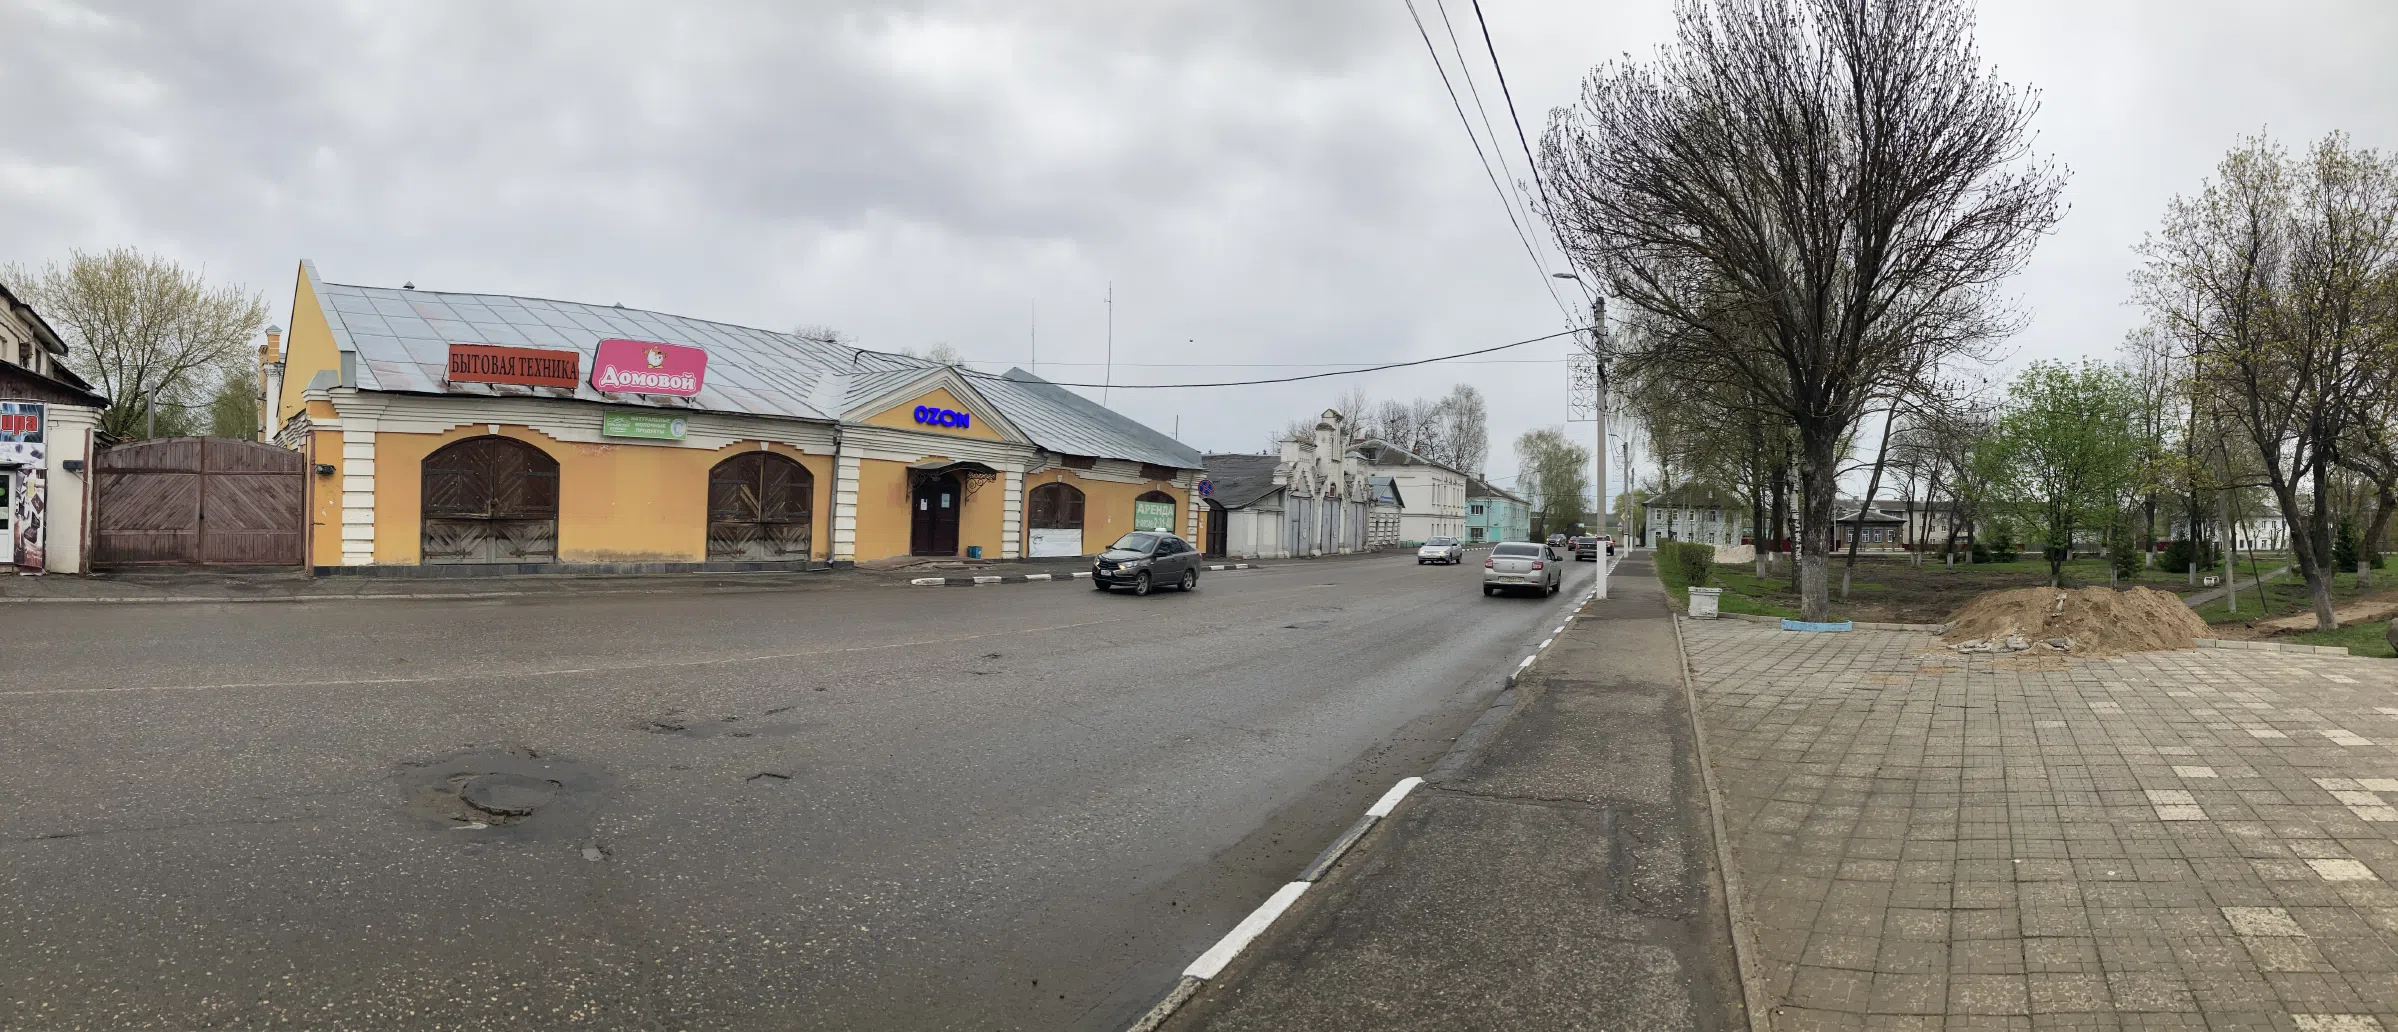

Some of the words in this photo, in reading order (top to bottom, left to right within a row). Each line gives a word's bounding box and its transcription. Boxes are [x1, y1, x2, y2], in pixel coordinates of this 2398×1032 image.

[451, 353, 516, 376] БЫТОВАЯ
[519, 357, 578, 380] ТЕХНИКА
[600, 365, 696, 391] Домовой
[631, 416, 671, 424] НАТУРАЛЬНЫЕ
[914, 405, 969, 428] OZON
[1137, 503, 1173, 517] АРЕНДА
